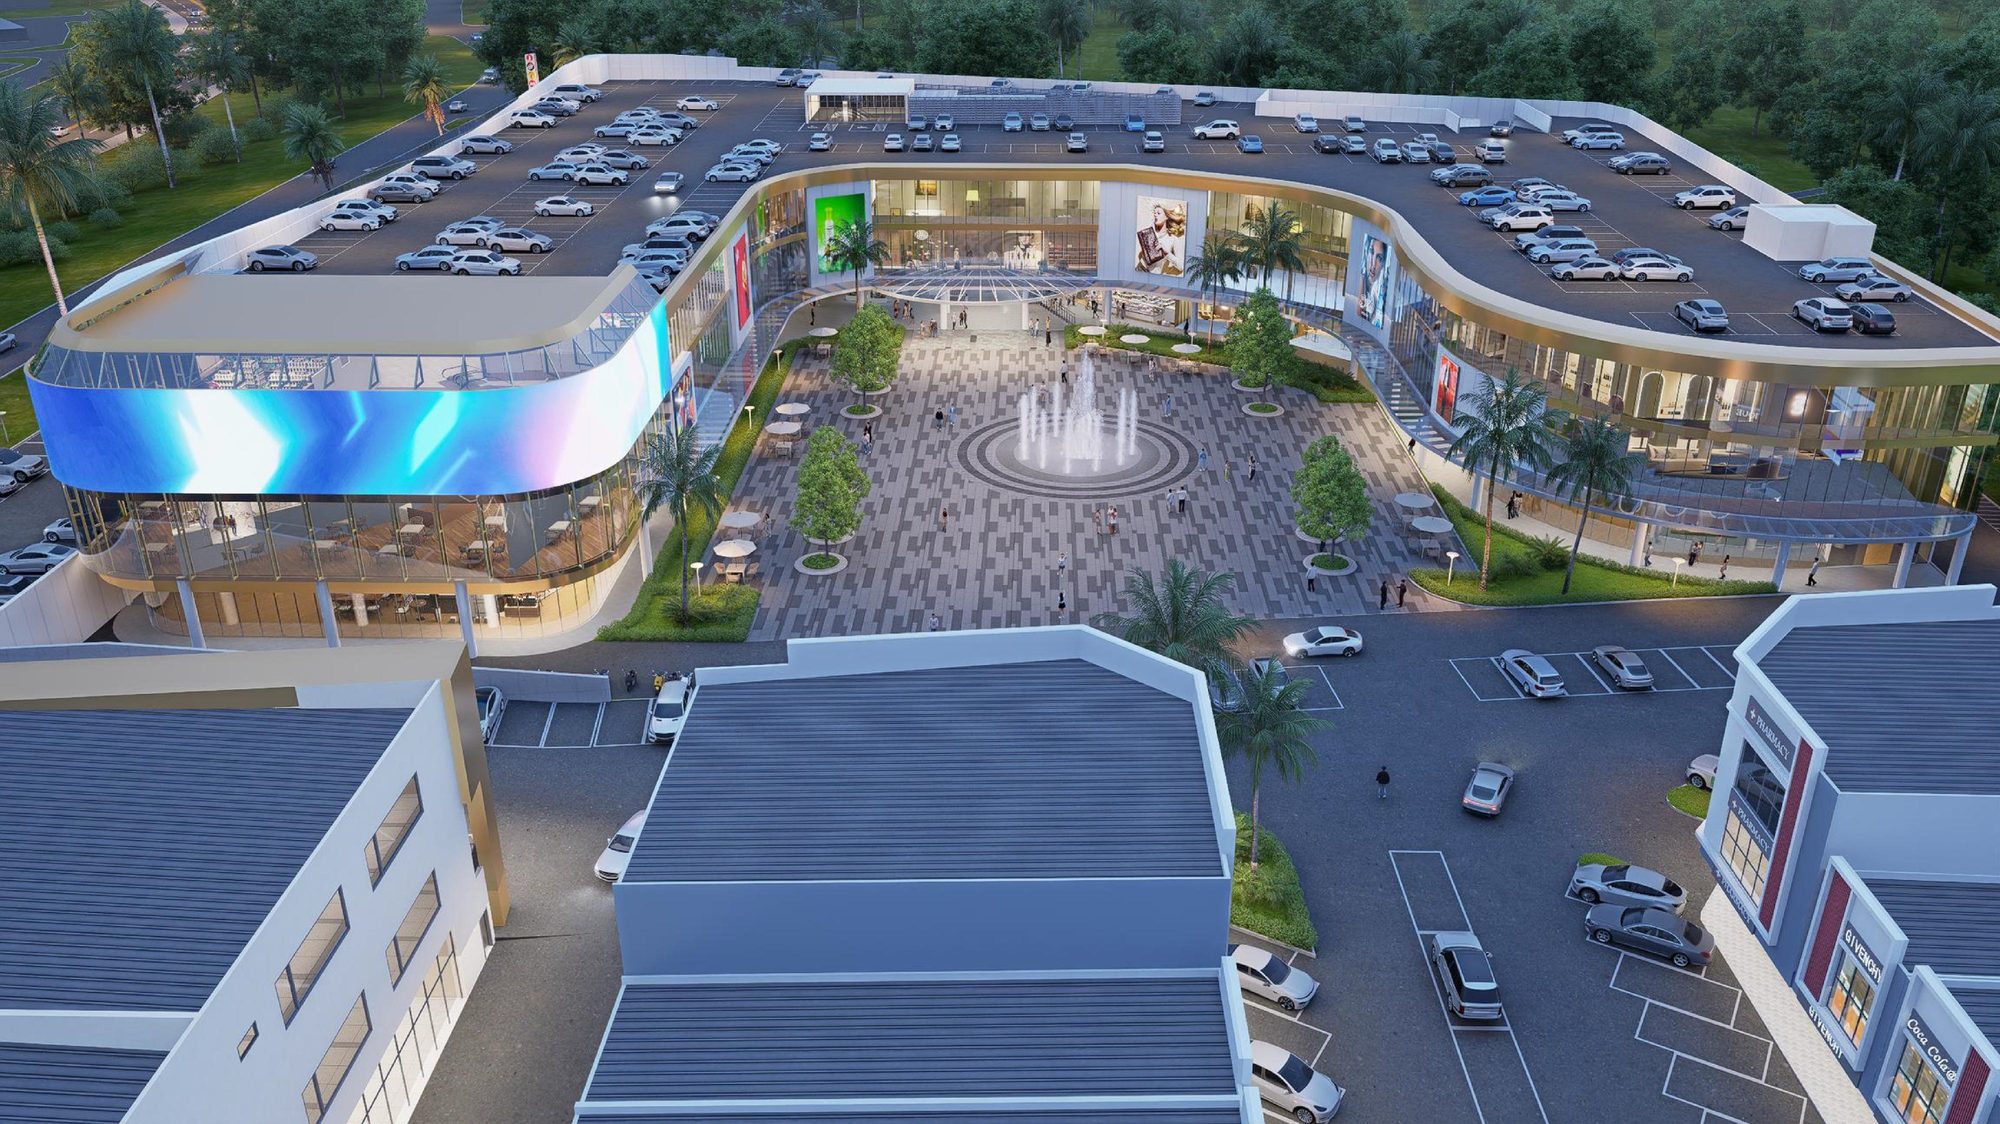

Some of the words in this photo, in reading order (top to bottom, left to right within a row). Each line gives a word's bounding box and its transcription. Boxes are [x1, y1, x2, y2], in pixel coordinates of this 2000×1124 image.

[1756, 715, 1790, 760] PHARMACY
[1737, 807, 1771, 852] PHARMACY
[1845, 929, 1882, 983] GIVENCHY
[1907, 1019, 1928, 1046] Coca
